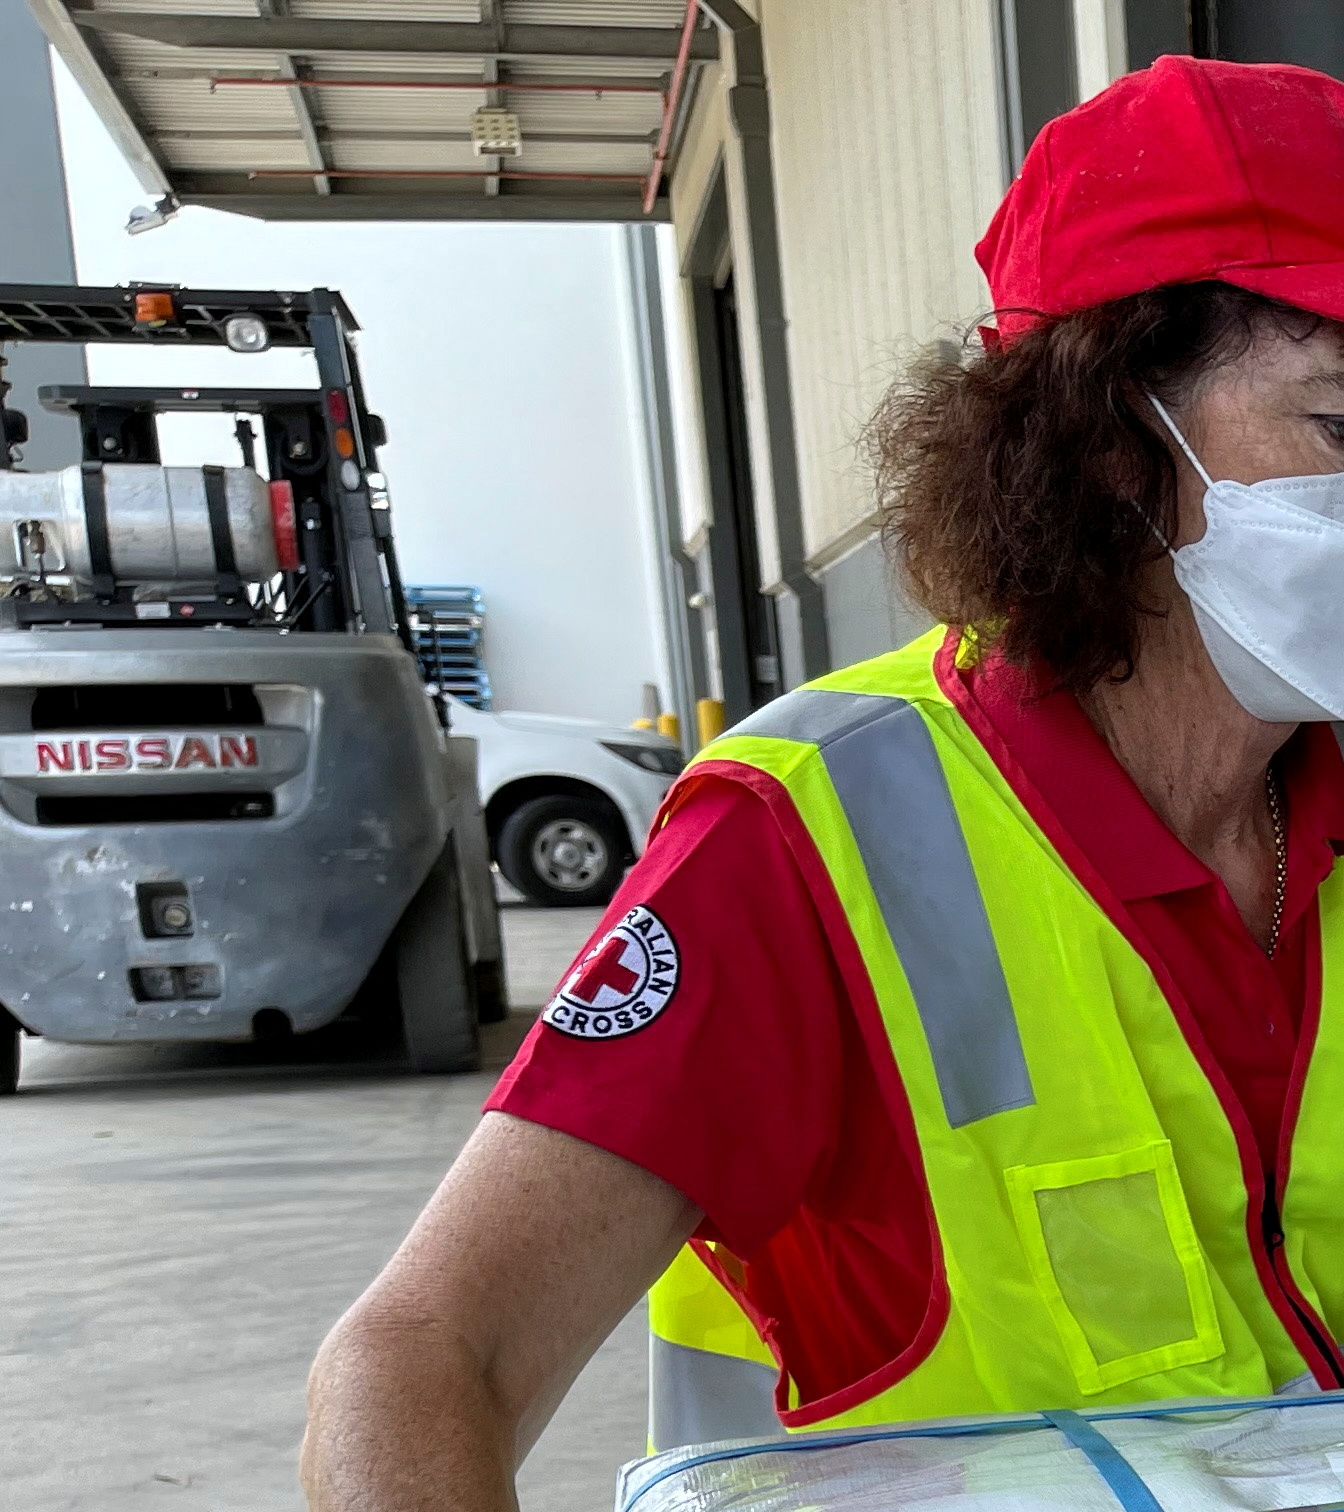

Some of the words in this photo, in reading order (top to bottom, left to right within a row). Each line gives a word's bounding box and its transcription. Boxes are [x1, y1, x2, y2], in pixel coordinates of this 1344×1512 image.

[36, 736, 260, 772] NISSAN
[623, 909, 675, 996] RALIAN
[551, 1001, 653, 1034] CROSS
